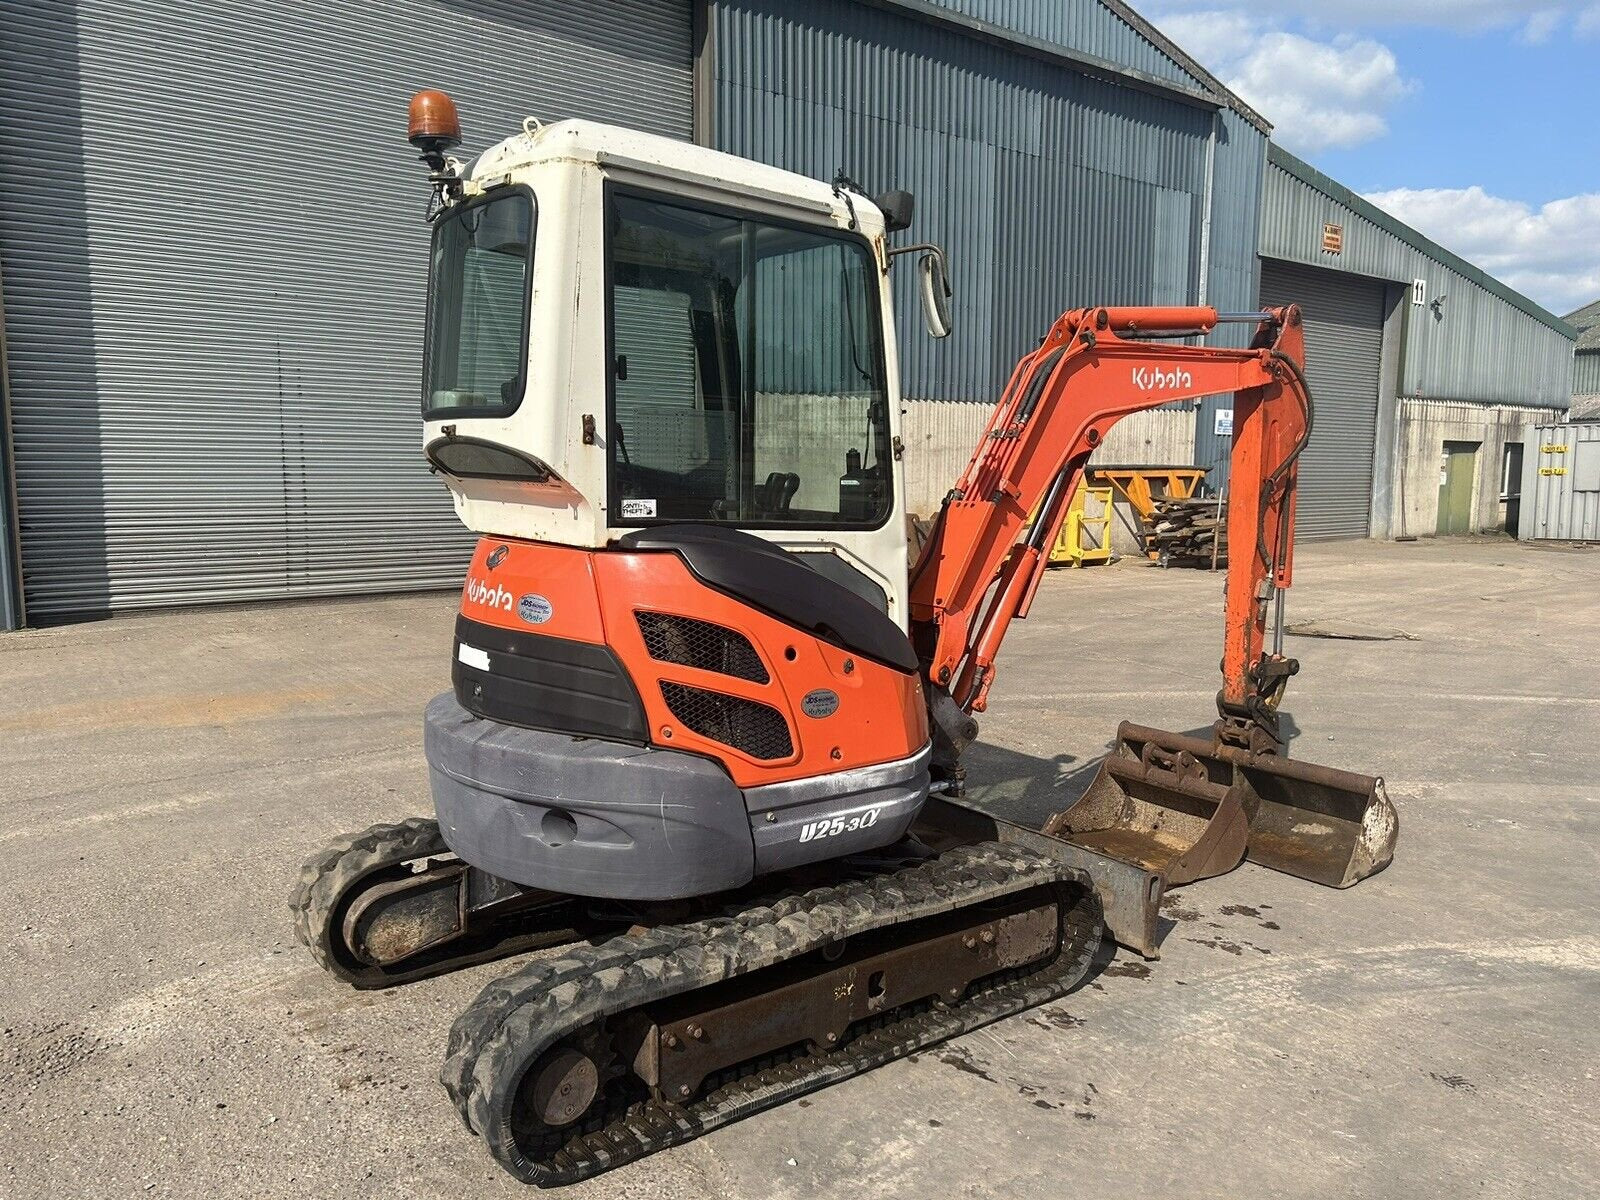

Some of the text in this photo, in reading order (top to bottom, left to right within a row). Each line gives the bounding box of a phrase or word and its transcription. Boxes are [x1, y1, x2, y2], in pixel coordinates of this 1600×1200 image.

[1415, 281, 1423, 302] 11
[1132, 367, 1191, 391] Kubota
[467, 577, 512, 610] Kubota
